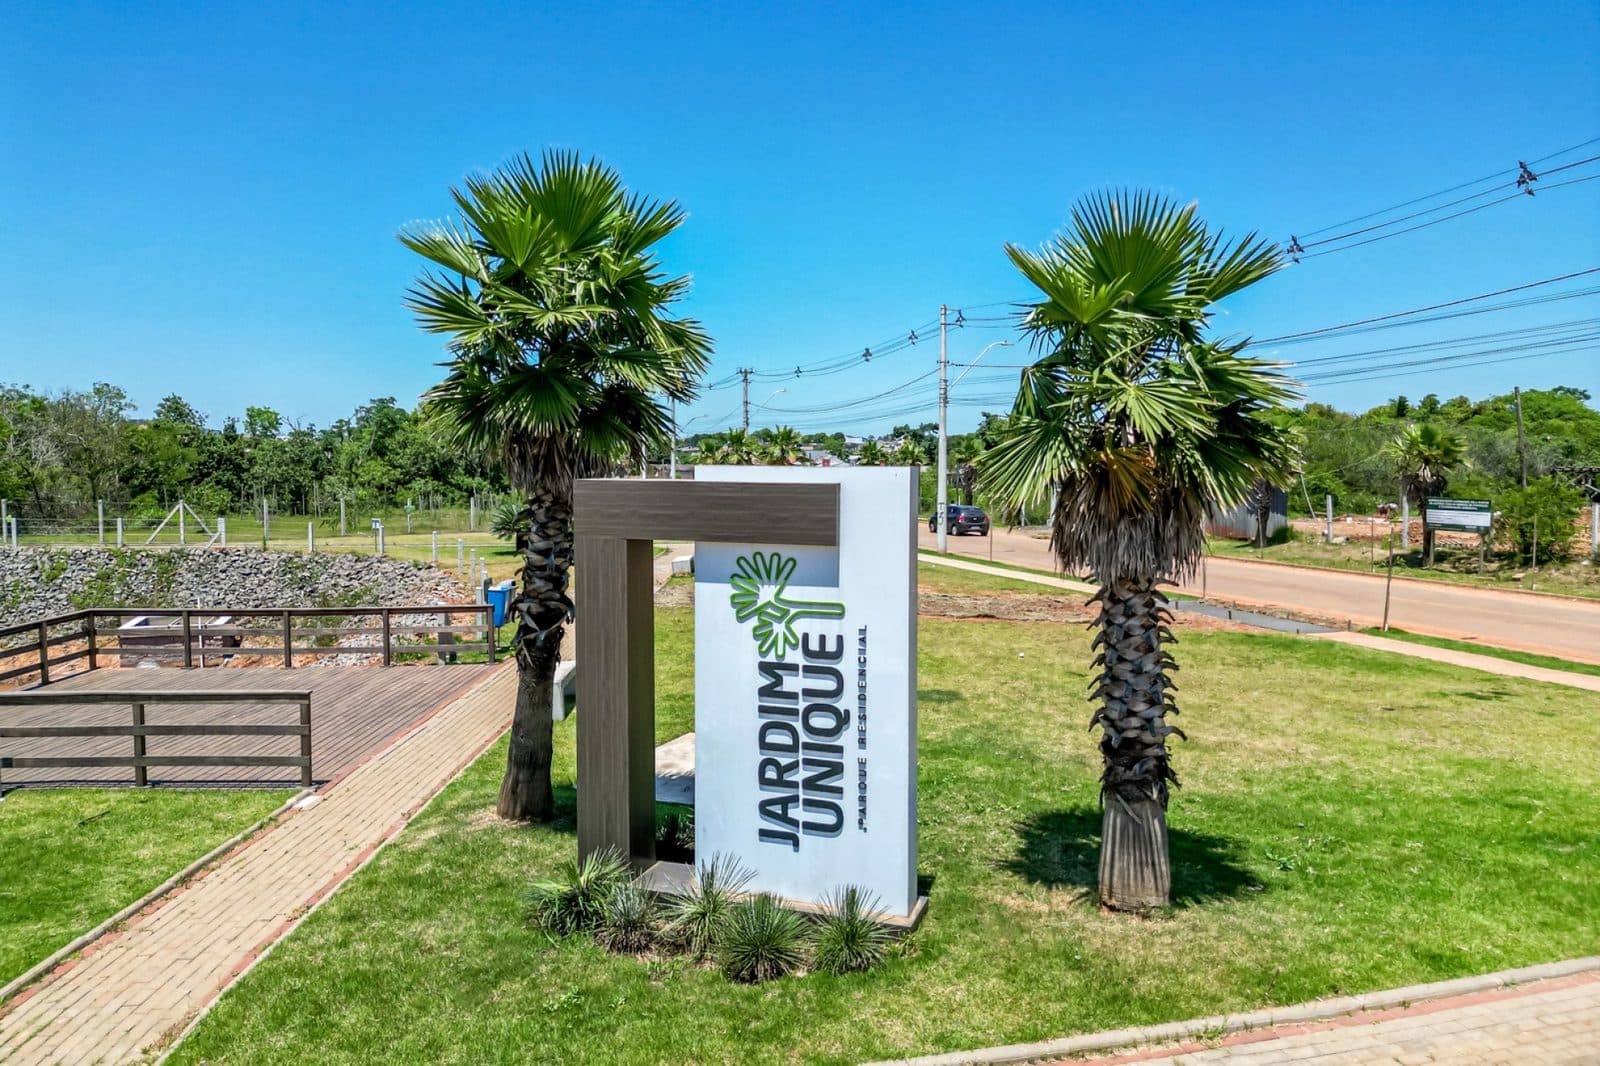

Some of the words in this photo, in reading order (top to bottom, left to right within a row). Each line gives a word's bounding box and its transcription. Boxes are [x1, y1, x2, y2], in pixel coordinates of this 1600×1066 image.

[757, 660, 800, 851] JARDIM
[801, 632, 850, 837] UNIQUE
[858, 625, 868, 748] RESIDENCIAL
[858, 757, 867, 831] PARQUE
